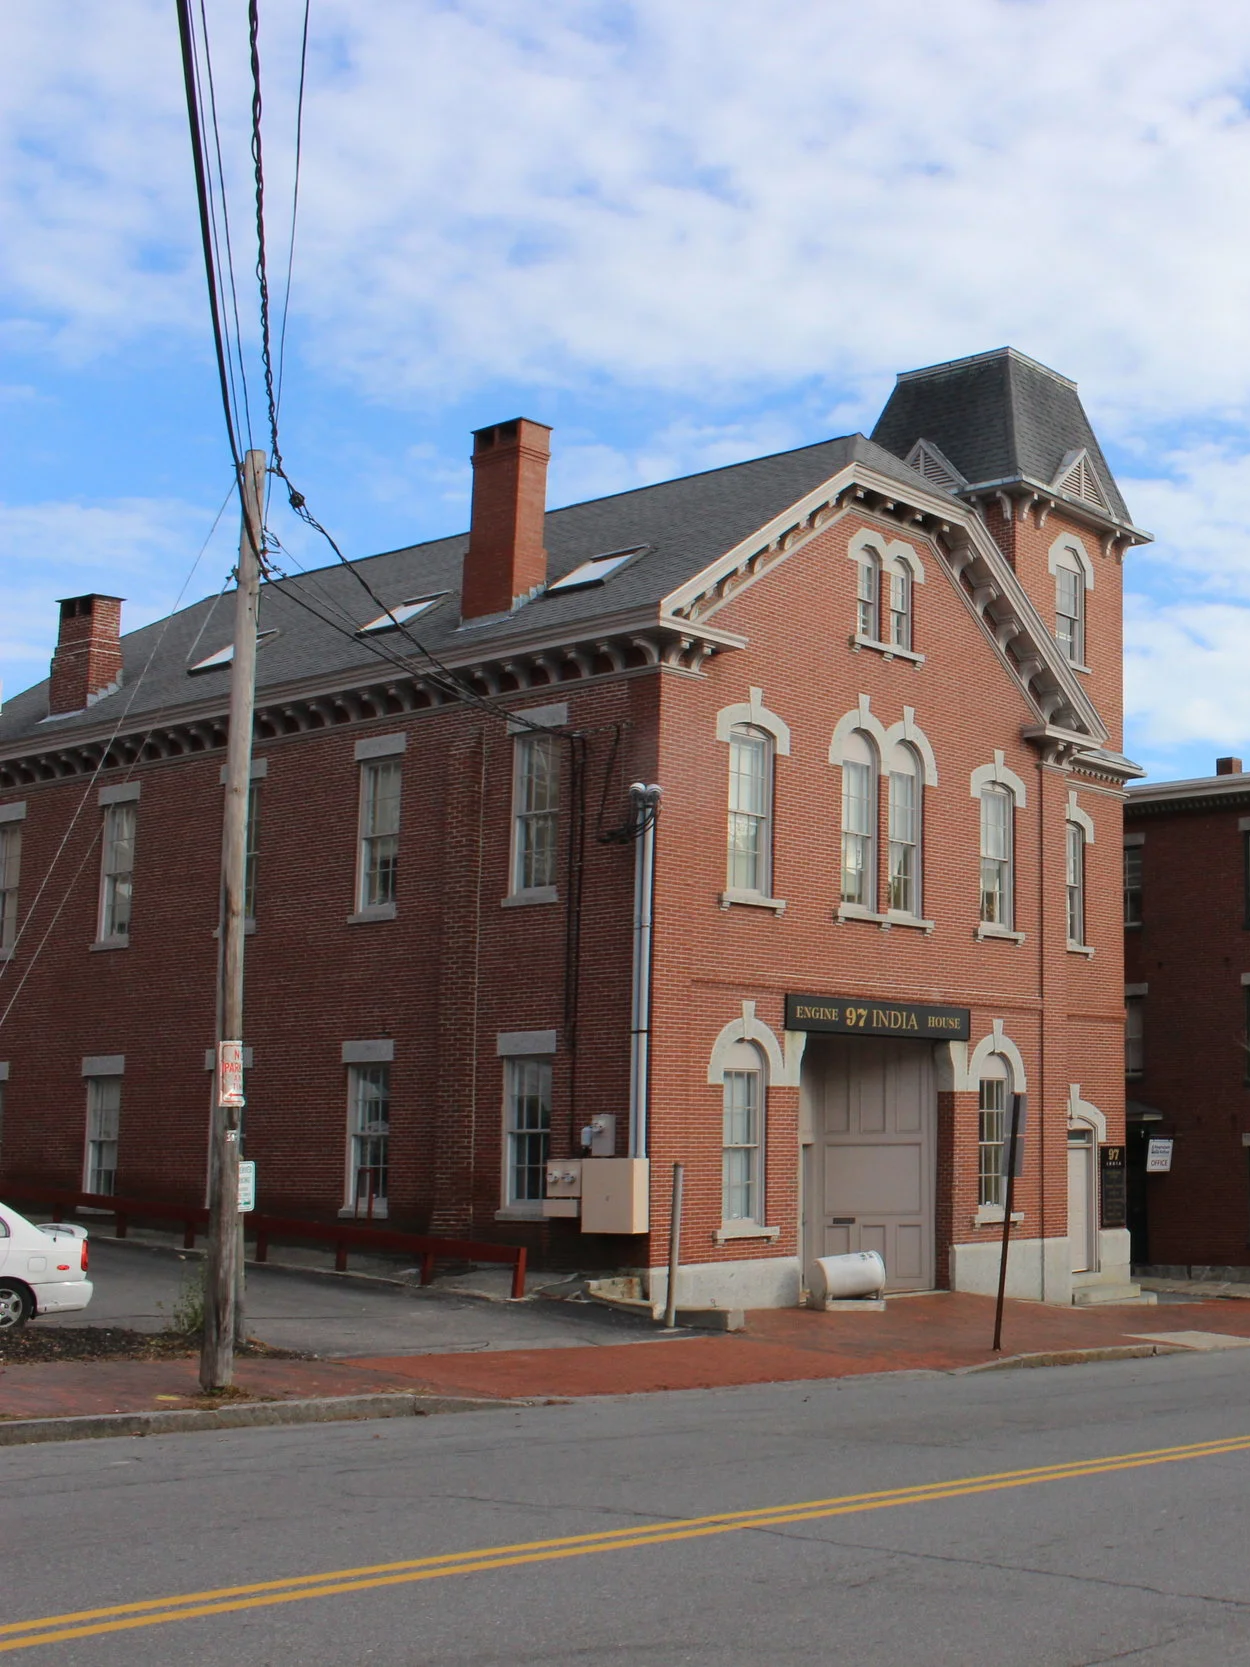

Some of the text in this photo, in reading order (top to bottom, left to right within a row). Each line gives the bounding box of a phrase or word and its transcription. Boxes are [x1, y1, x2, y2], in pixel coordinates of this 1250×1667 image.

[796, 1006, 961, 1030] ENGINE 97 INDIA HOUSE
[1108, 1149, 1119, 1160] 97
